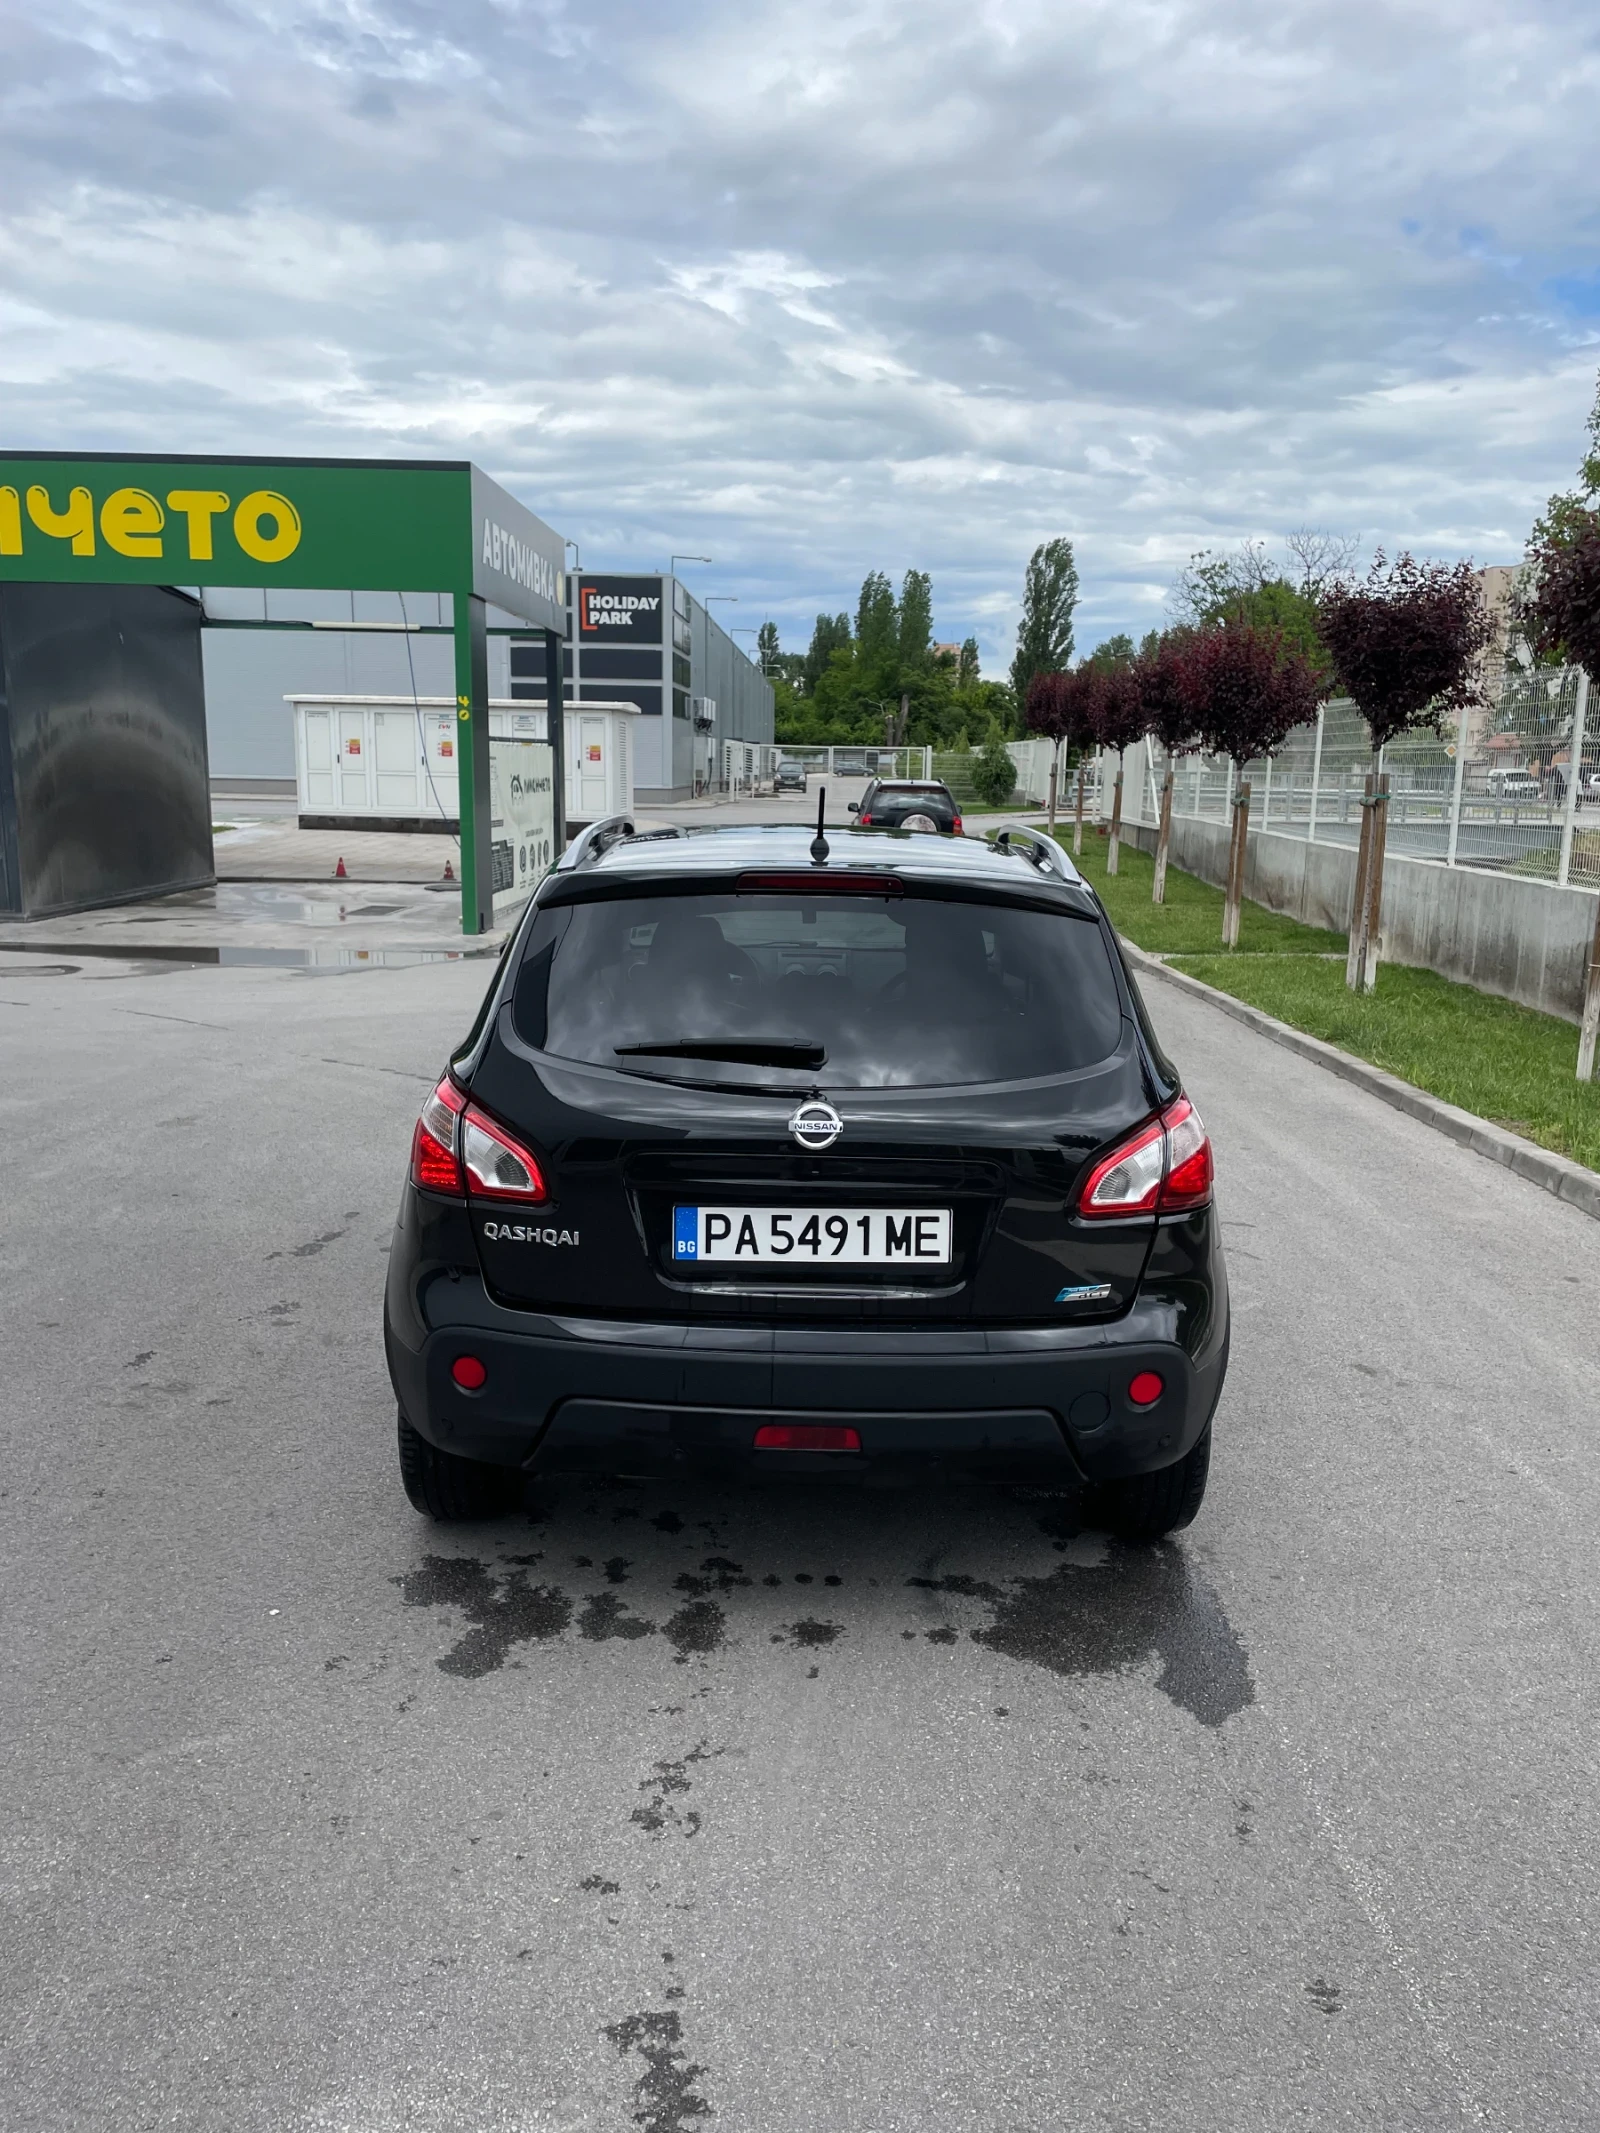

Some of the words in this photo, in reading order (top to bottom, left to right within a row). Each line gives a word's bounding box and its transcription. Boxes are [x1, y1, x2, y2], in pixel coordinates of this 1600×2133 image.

[482, 518, 556, 604] АВТОМИВКА
[588, 595, 660, 611] HOLIDAY
[589, 611, 633, 625] PARK
[794, 1122, 838, 1131] NISSAN
[483, 1222, 580, 1247] QASHQAI
[677, 1240, 696, 1253] BG
